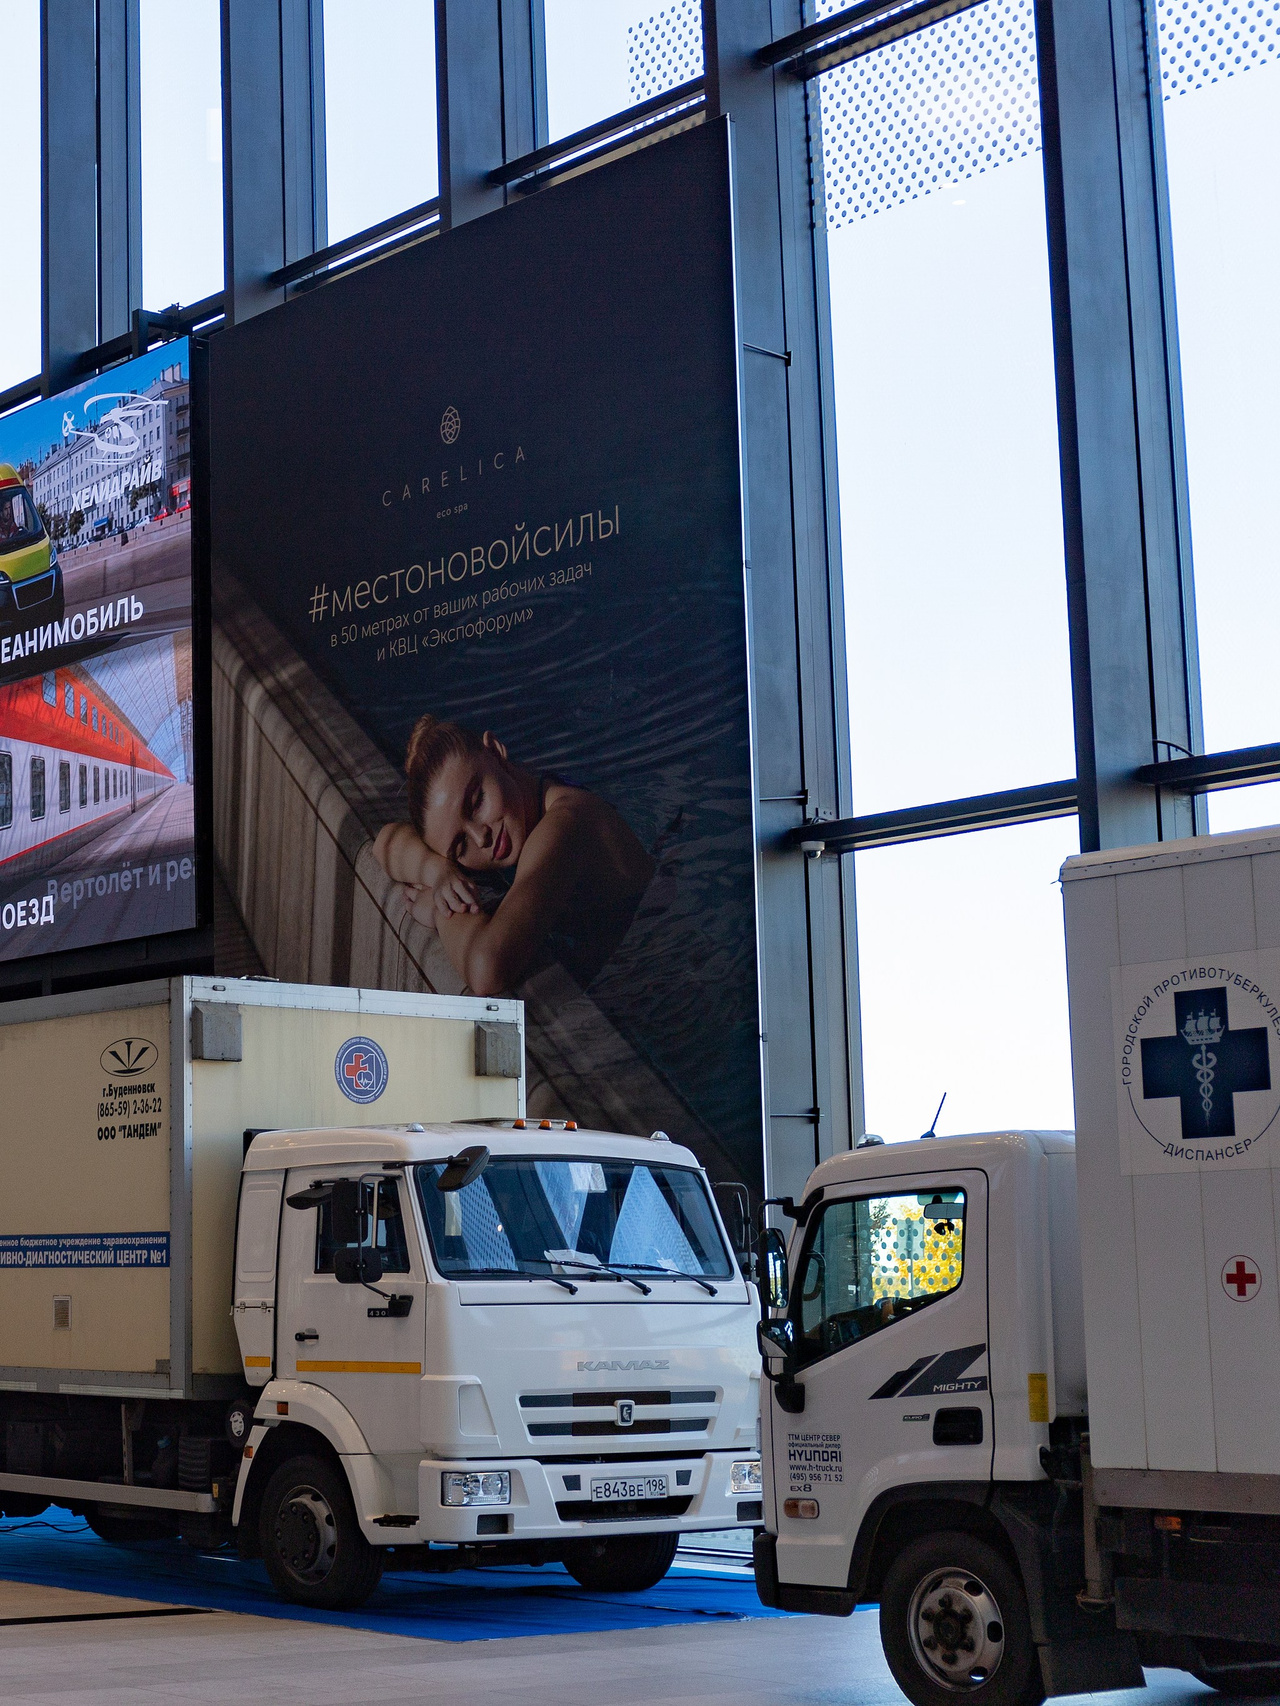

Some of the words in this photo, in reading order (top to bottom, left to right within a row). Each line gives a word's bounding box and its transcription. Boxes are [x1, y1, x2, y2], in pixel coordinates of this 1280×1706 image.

[70, 455, 163, 514] ХЕЛИДРАЙВ
[382, 446, 526, 506] CARELICA
[436, 507, 452, 519] eco
[454, 502, 468, 518] spa
[330, 632, 338, 647] в
[341, 623, 358, 645] 50
[361, 612, 410, 643] метрах
[413, 607, 428, 624] от
[434, 595, 478, 618] ваших
[482, 572, 546, 613] рабочих
[549, 560, 592, 586] задач
[376, 646, 384, 661] и
[389, 635, 418, 658] КВЦ
[421, 608, 533, 648] «Экспофорум»
[47, 862, 144, 906] Вертолёт
[149, 864, 160, 886] и
[166, 858, 195, 892] ре
[1122, 995, 1154, 1086] ГОРОДСКОЙ
[102, 1083, 155, 1099] г.Буденновск
[98, 1100, 130, 1121] (865-59)
[133, 1098, 162, 1114] 2-36-22
[98, 1126, 116, 1140] ООО
[118, 1122, 162, 1140] "ТАНДЕМ"
[1164, 1138, 1252, 1161] ДИСПАНСЕР
[20, 1237, 57, 1248] бюджетное
[58, 1237, 100, 1248] учреждение
[102, 1236, 166, 1246] здравоохранения
[116, 1250, 148, 1266] ЦЕНТР
[150, 1249, 166, 1264] №1
[577, 1360, 670, 1372] KAMAZ
[934, 1380, 982, 1392] MIGHTY
[801, 1434, 820, 1442] ЦЕНТР
[822, 1434, 840, 1442] СЕВЕР
[788, 1450, 842, 1462] HYUNDAI
[790, 1463, 842, 1472] www.h-truck.ru
[646, 1479, 663, 1492] 198
[790, 1473, 806, 1482] (495)
[824, 1474, 832, 1482] 71
[834, 1474, 842, 1482] 52
[790, 1484, 812, 1492] EX8
